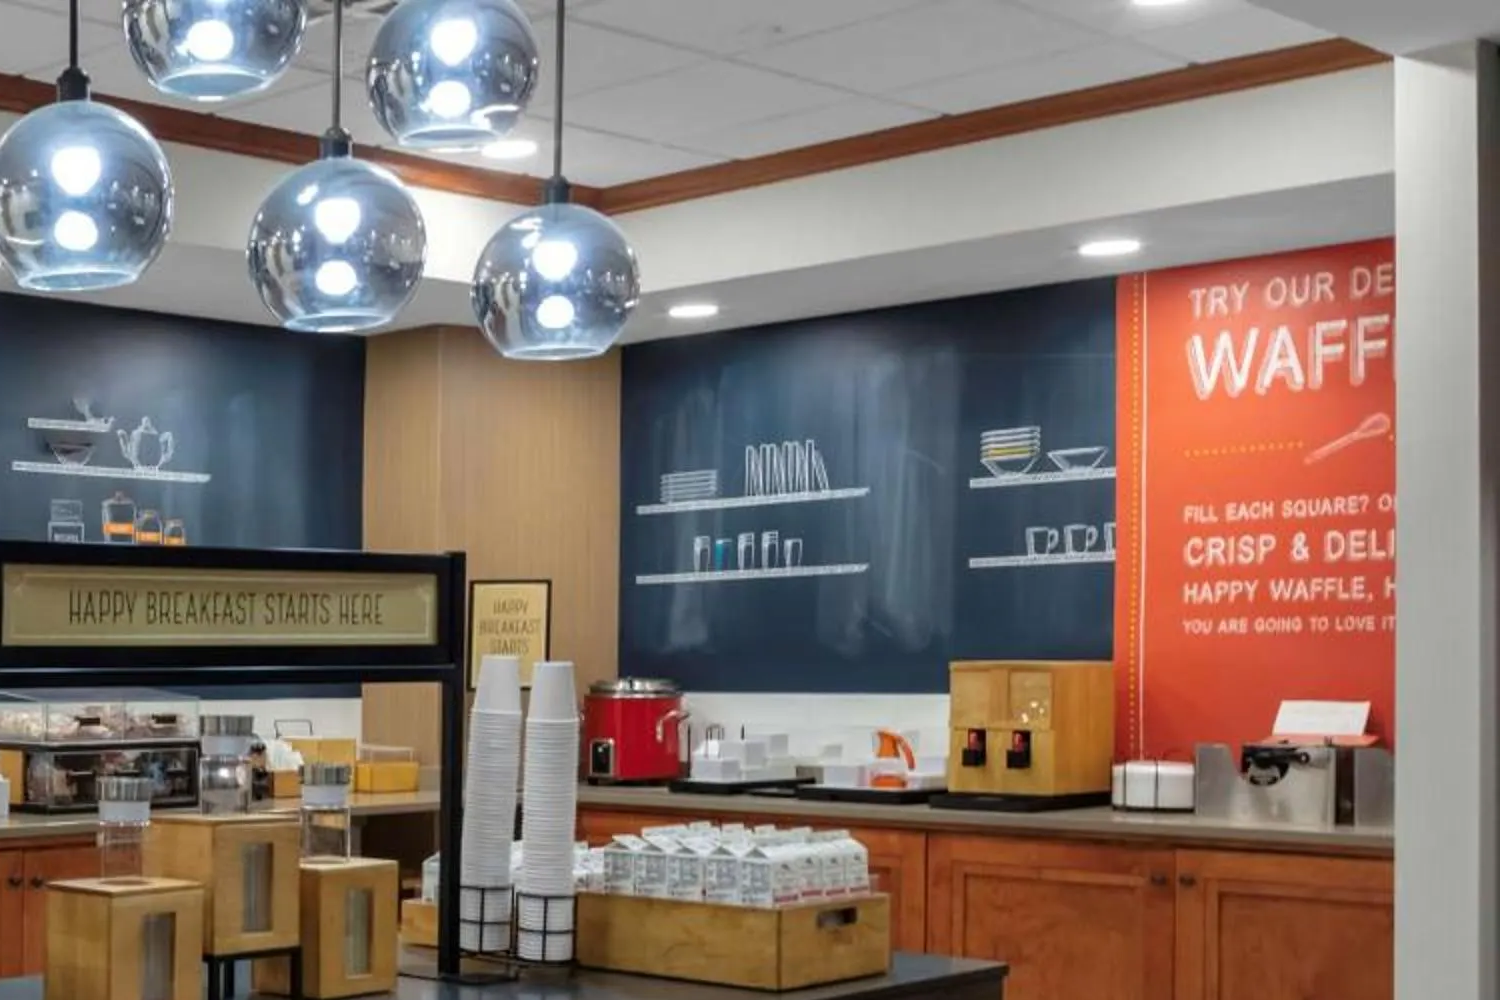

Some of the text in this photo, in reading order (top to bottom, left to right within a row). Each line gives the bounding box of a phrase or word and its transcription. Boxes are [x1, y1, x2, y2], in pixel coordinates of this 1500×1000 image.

[1188, 281, 1250, 319] TRY
[1266, 271, 1336, 310] OUR
[1186, 314, 1396, 401] WAFF
[1183, 493, 1396, 524] FILL EACH SQUARE? O
[1183, 532, 1277, 568] CRISP
[1290, 530, 1311, 562] &
[68, 588, 384, 626] HAPPY BREAKFAST STARTS HERE
[493, 599, 530, 615] HAPPY
[1184, 579, 1259, 604] HAPPY
[1270, 576, 1373, 602] WAFFLE,
[1183, 618, 1212, 635] YOU
[1218, 618, 1248, 634] ARE
[1254, 616, 1302, 634] GOING
[1310, 616, 1330, 632] TO
[1335, 615, 1375, 632] LOVE
